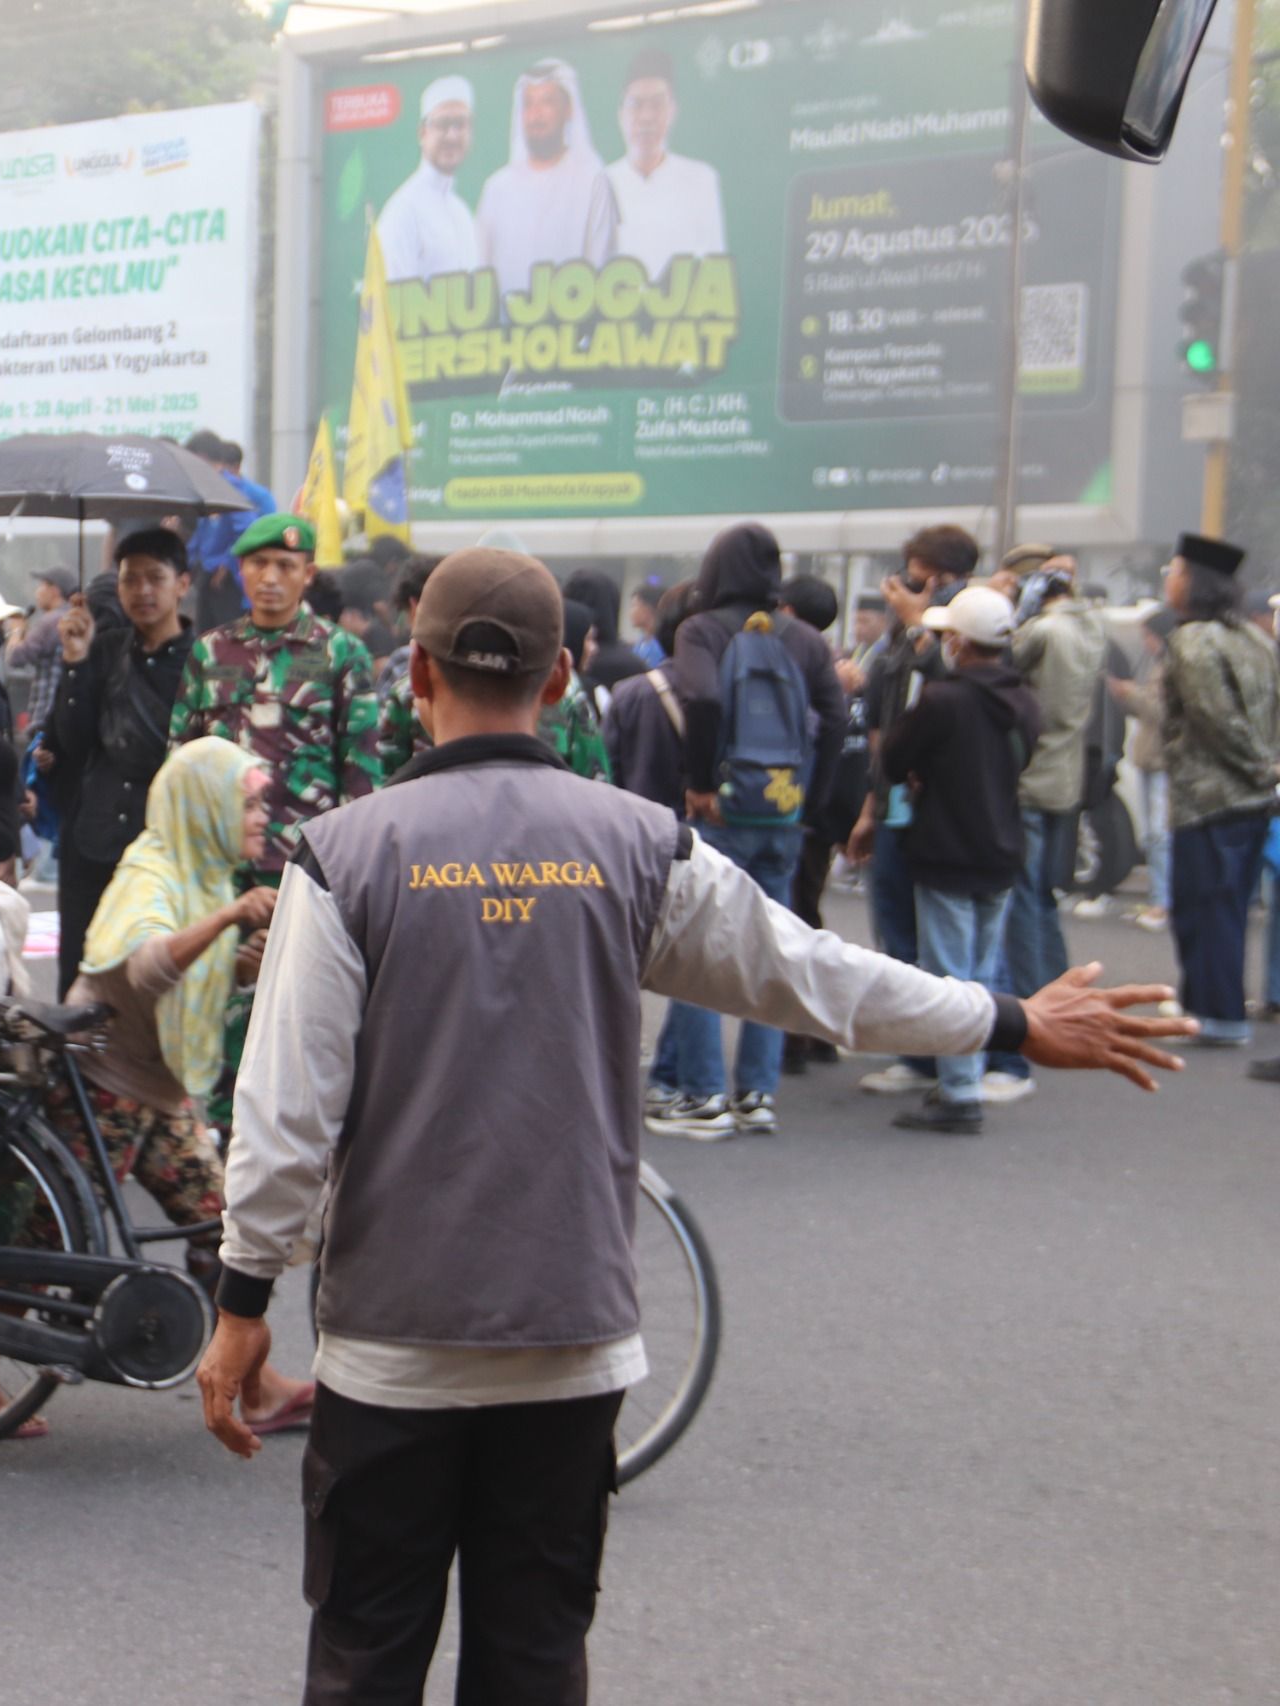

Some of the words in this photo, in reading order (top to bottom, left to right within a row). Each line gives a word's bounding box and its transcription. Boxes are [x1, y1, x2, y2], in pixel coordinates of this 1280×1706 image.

[790, 124, 858, 151] Maulid
[861, 117, 910, 142] Nabi
[92, 208, 226, 252] CITA-CITA
[804, 230, 841, 262] 29
[843, 226, 958, 265] Agustus
[52, 254, 180, 299] KECILMU"
[505, 254, 738, 325] JOGJA
[72, 323, 164, 346] Gelombang
[167, 321, 177, 339] 2
[827, 308, 884, 334] 18.30
[59, 353, 107, 373] UNISA
[113, 349, 208, 374] Yogyakarta
[55, 397, 92, 420] April
[127, 394, 157, 413] Mei
[162, 392, 199, 411] 2025
[450, 411, 469, 429] Dr.
[474, 406, 564, 428] Mohammad
[637, 397, 659, 417] Dr.
[678, 415, 751, 437] Mustofa
[409, 863, 486, 888] JAGA
[490, 861, 605, 887] WARGA
[480, 897, 536, 922] DIY
